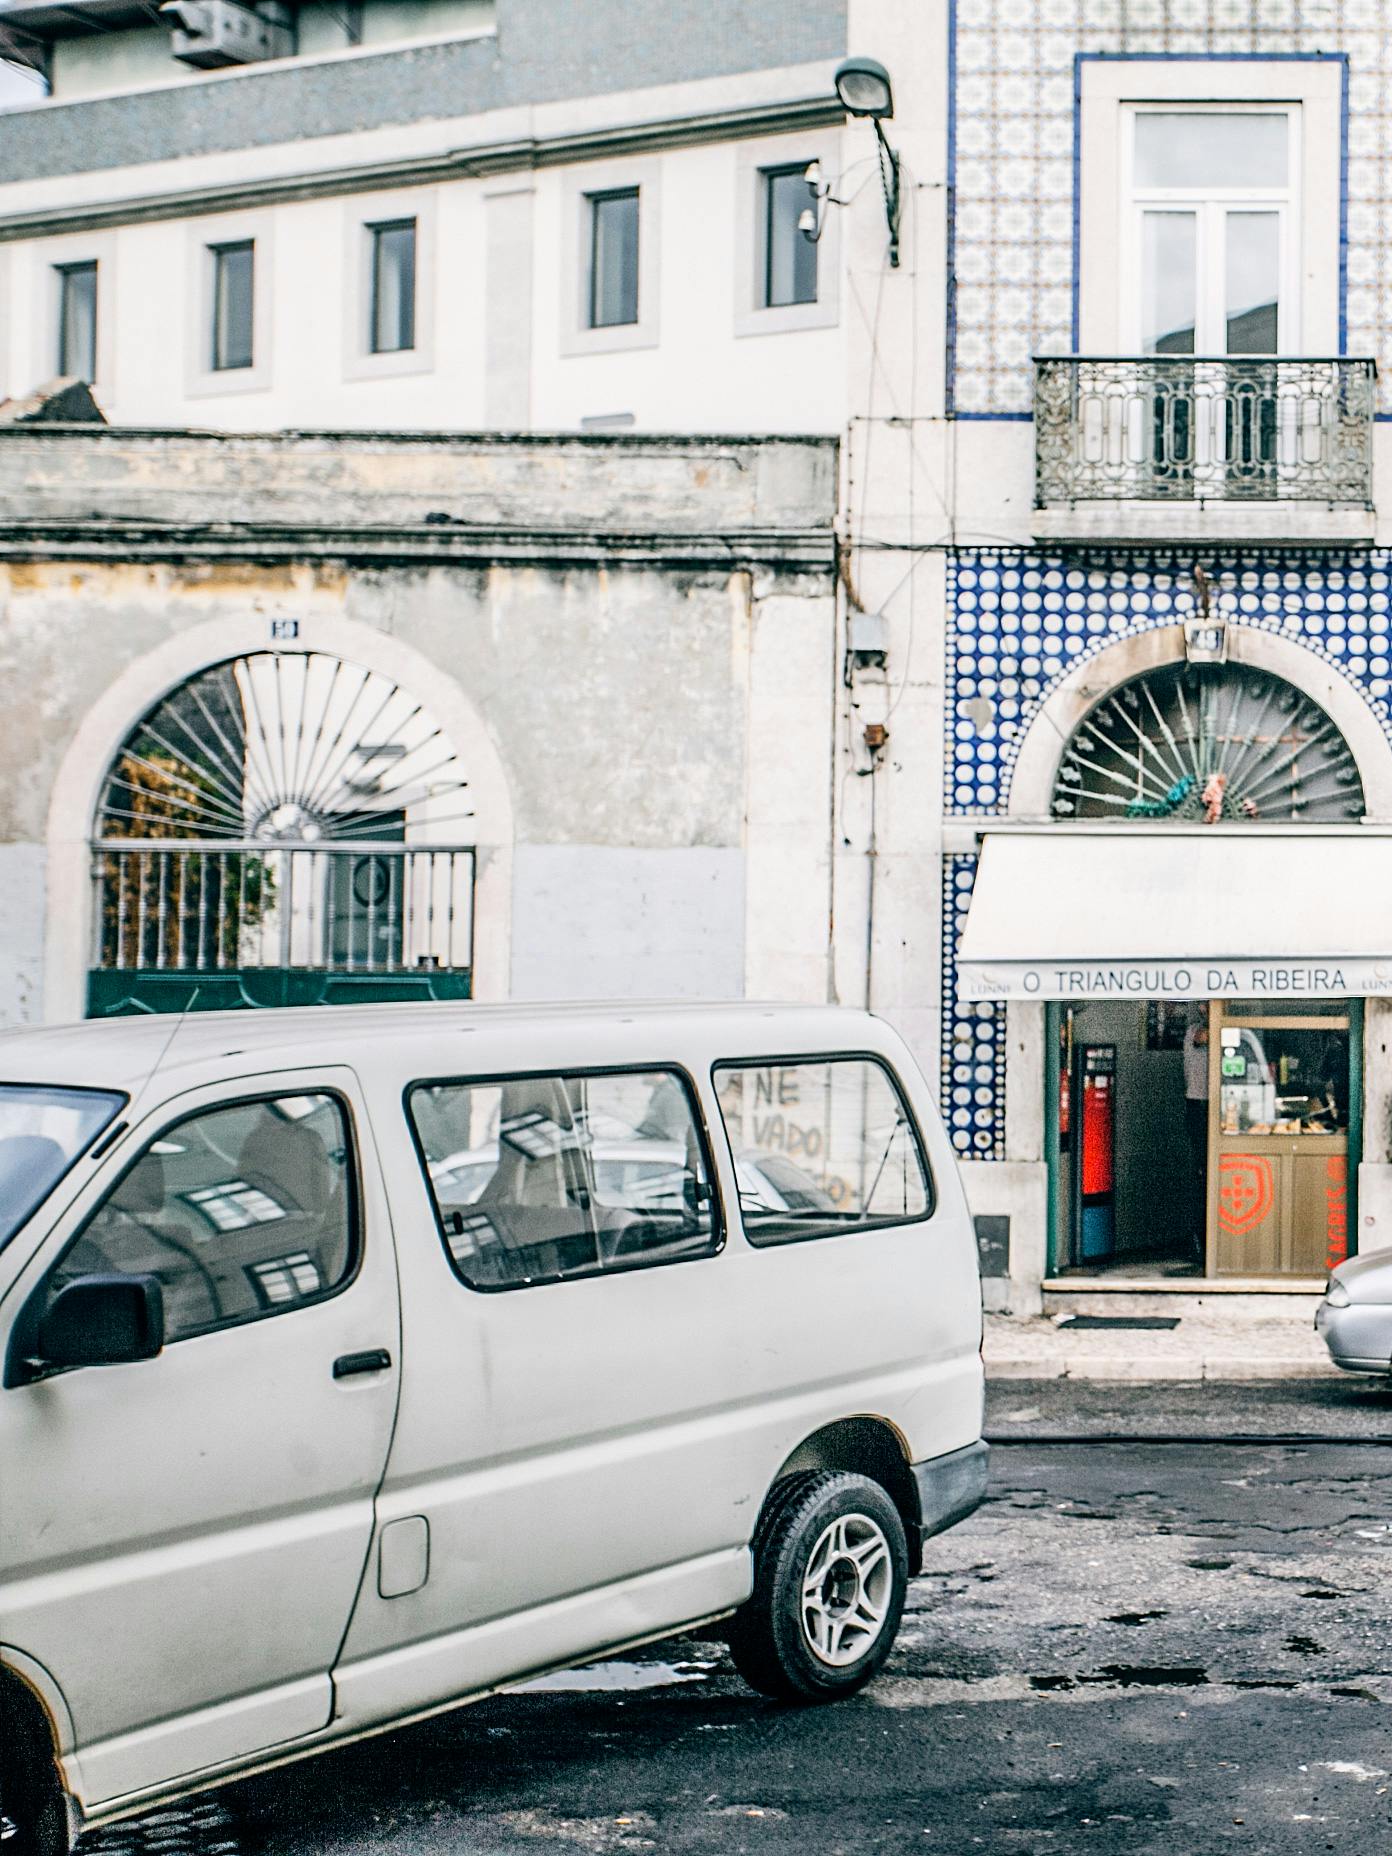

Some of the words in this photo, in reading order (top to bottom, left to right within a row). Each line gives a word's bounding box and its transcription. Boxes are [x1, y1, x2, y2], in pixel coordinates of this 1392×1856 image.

[1023, 971, 1041, 993] O
[1055, 969, 1194, 993] TRIANGULO
[1206, 969, 1239, 991] DA
[1251, 968, 1347, 991] RIBEIRA
[752, 1113, 822, 1158] VADO
